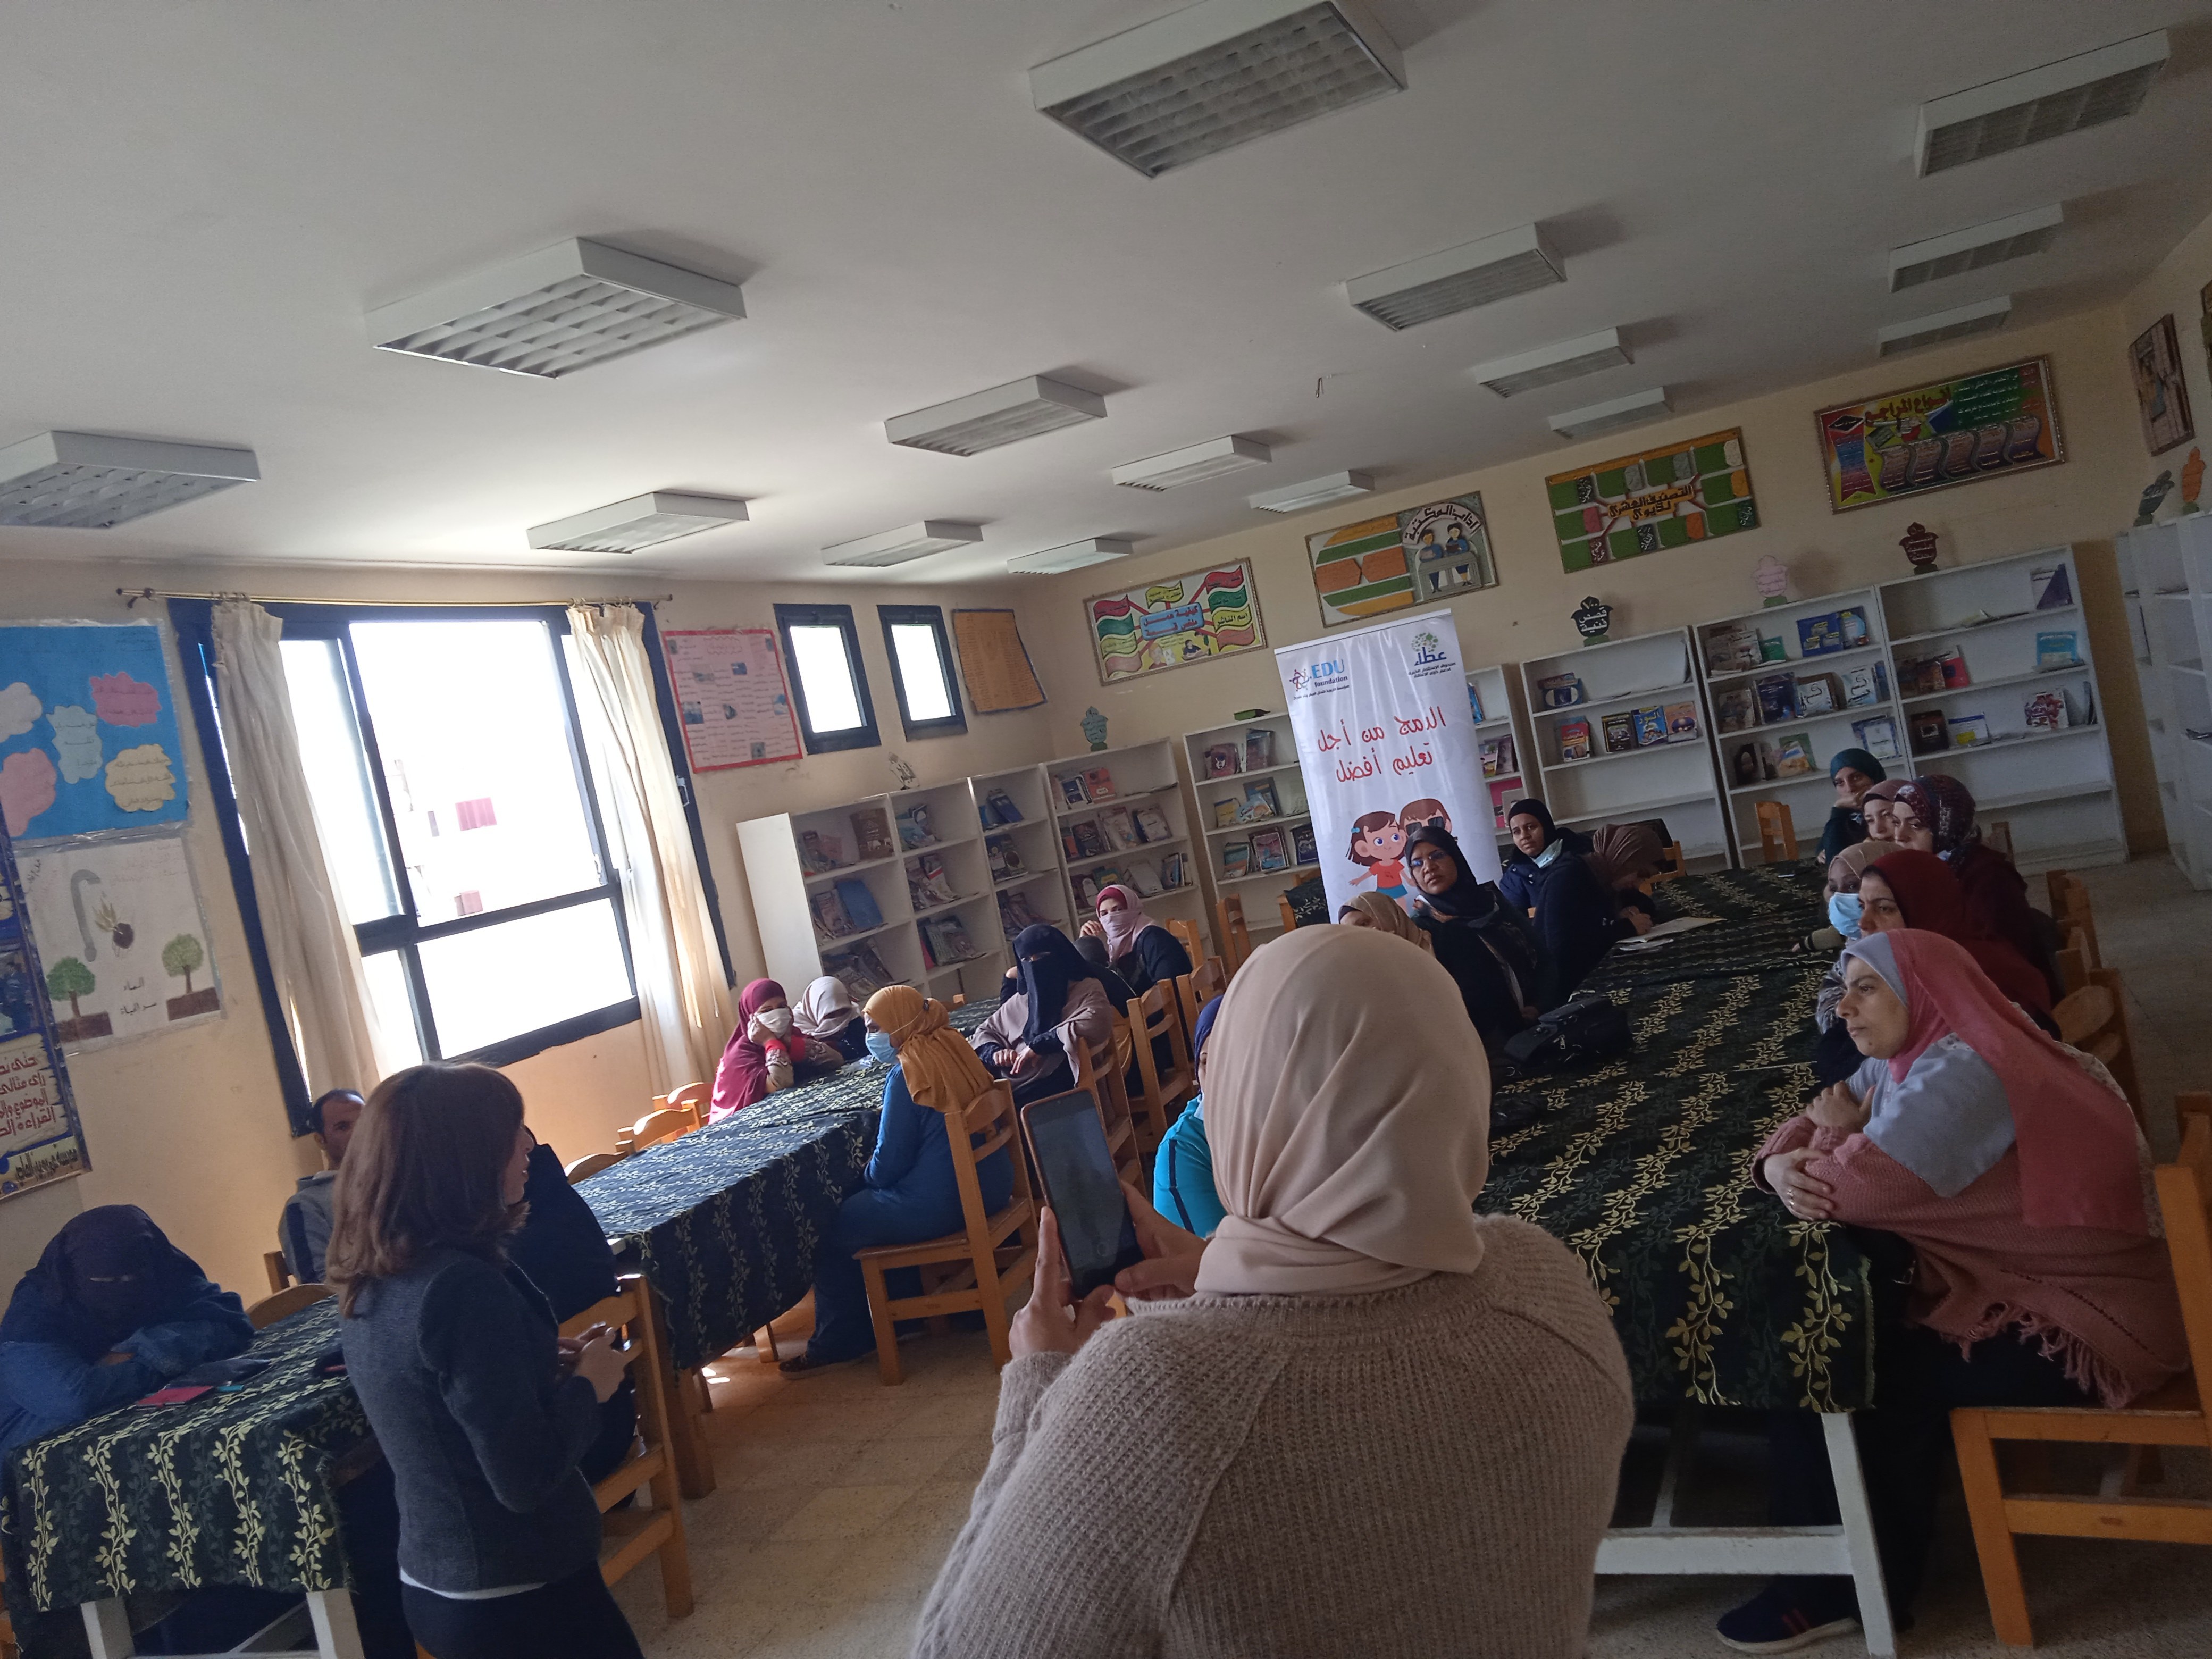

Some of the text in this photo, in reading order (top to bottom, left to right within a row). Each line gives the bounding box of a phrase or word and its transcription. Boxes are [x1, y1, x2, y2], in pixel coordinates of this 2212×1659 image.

[1580, 618, 1608, 633] فنية
[1414, 646, 1447, 666] عطاء
[1311, 659, 1345, 679] EDU
[1314, 675, 1348, 688] foundation
[1317, 706, 1446, 753] الدمج من أجل
[1336, 742, 1433, 783] تعليم أفضل
